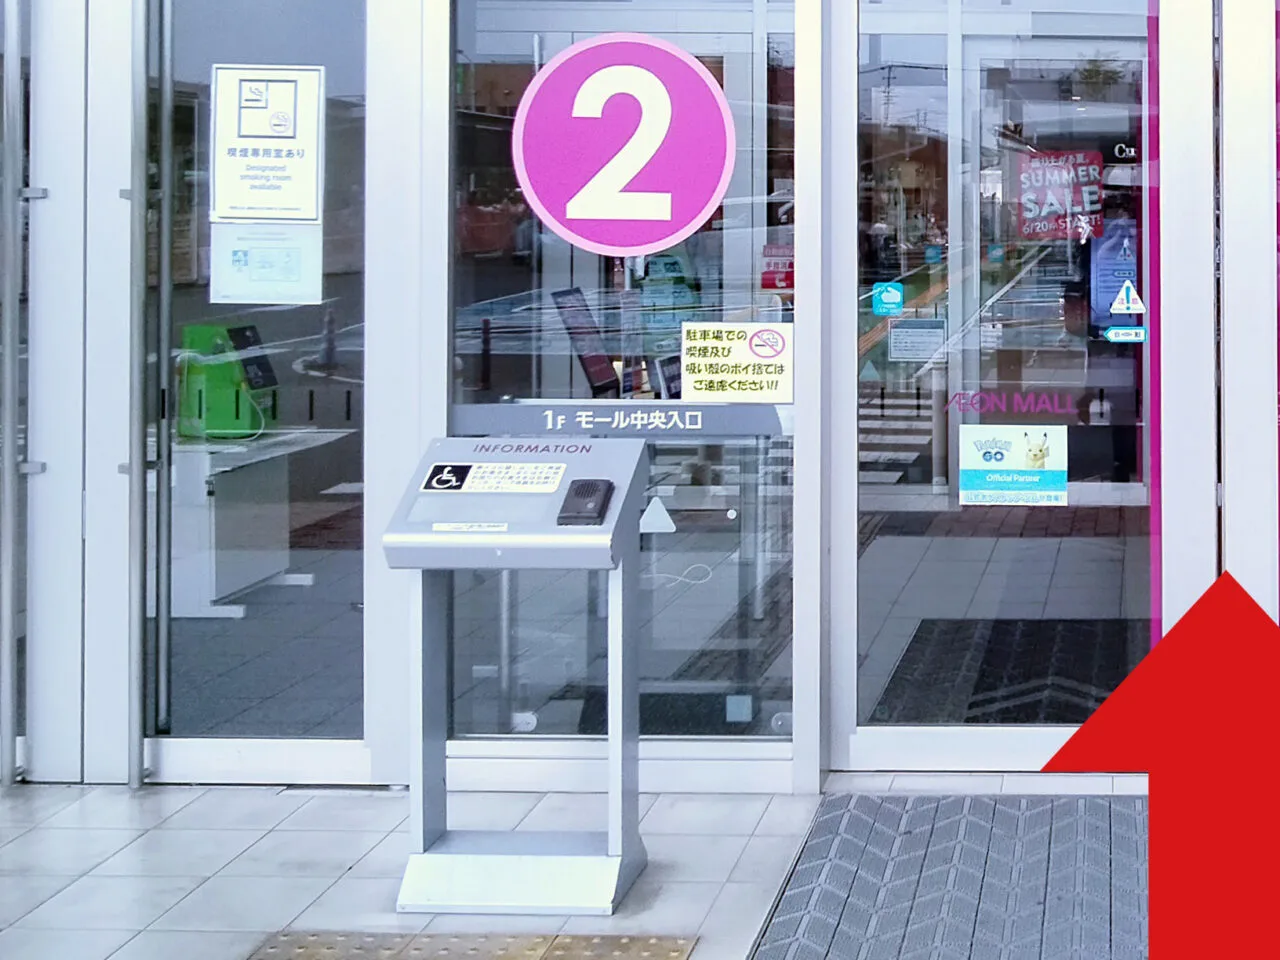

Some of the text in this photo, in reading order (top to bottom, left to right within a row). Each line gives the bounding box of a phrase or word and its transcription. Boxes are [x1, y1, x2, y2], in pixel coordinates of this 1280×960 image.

[564, 64, 674, 222] 2
[1020, 164, 1101, 189] SUMMER
[1021, 185, 1102, 219] SALE
[686, 329, 748, 341] 駐車場での
[686, 346, 732, 358] 喫煙及び
[685, 363, 785, 375] 吸い殻のポイ捨ては
[1013, 392, 1079, 414] MALL
[543, 410, 702, 430] 1F モール中央入口
[473, 444, 592, 454] INFORMATION
[982, 451, 1004, 462] GO
